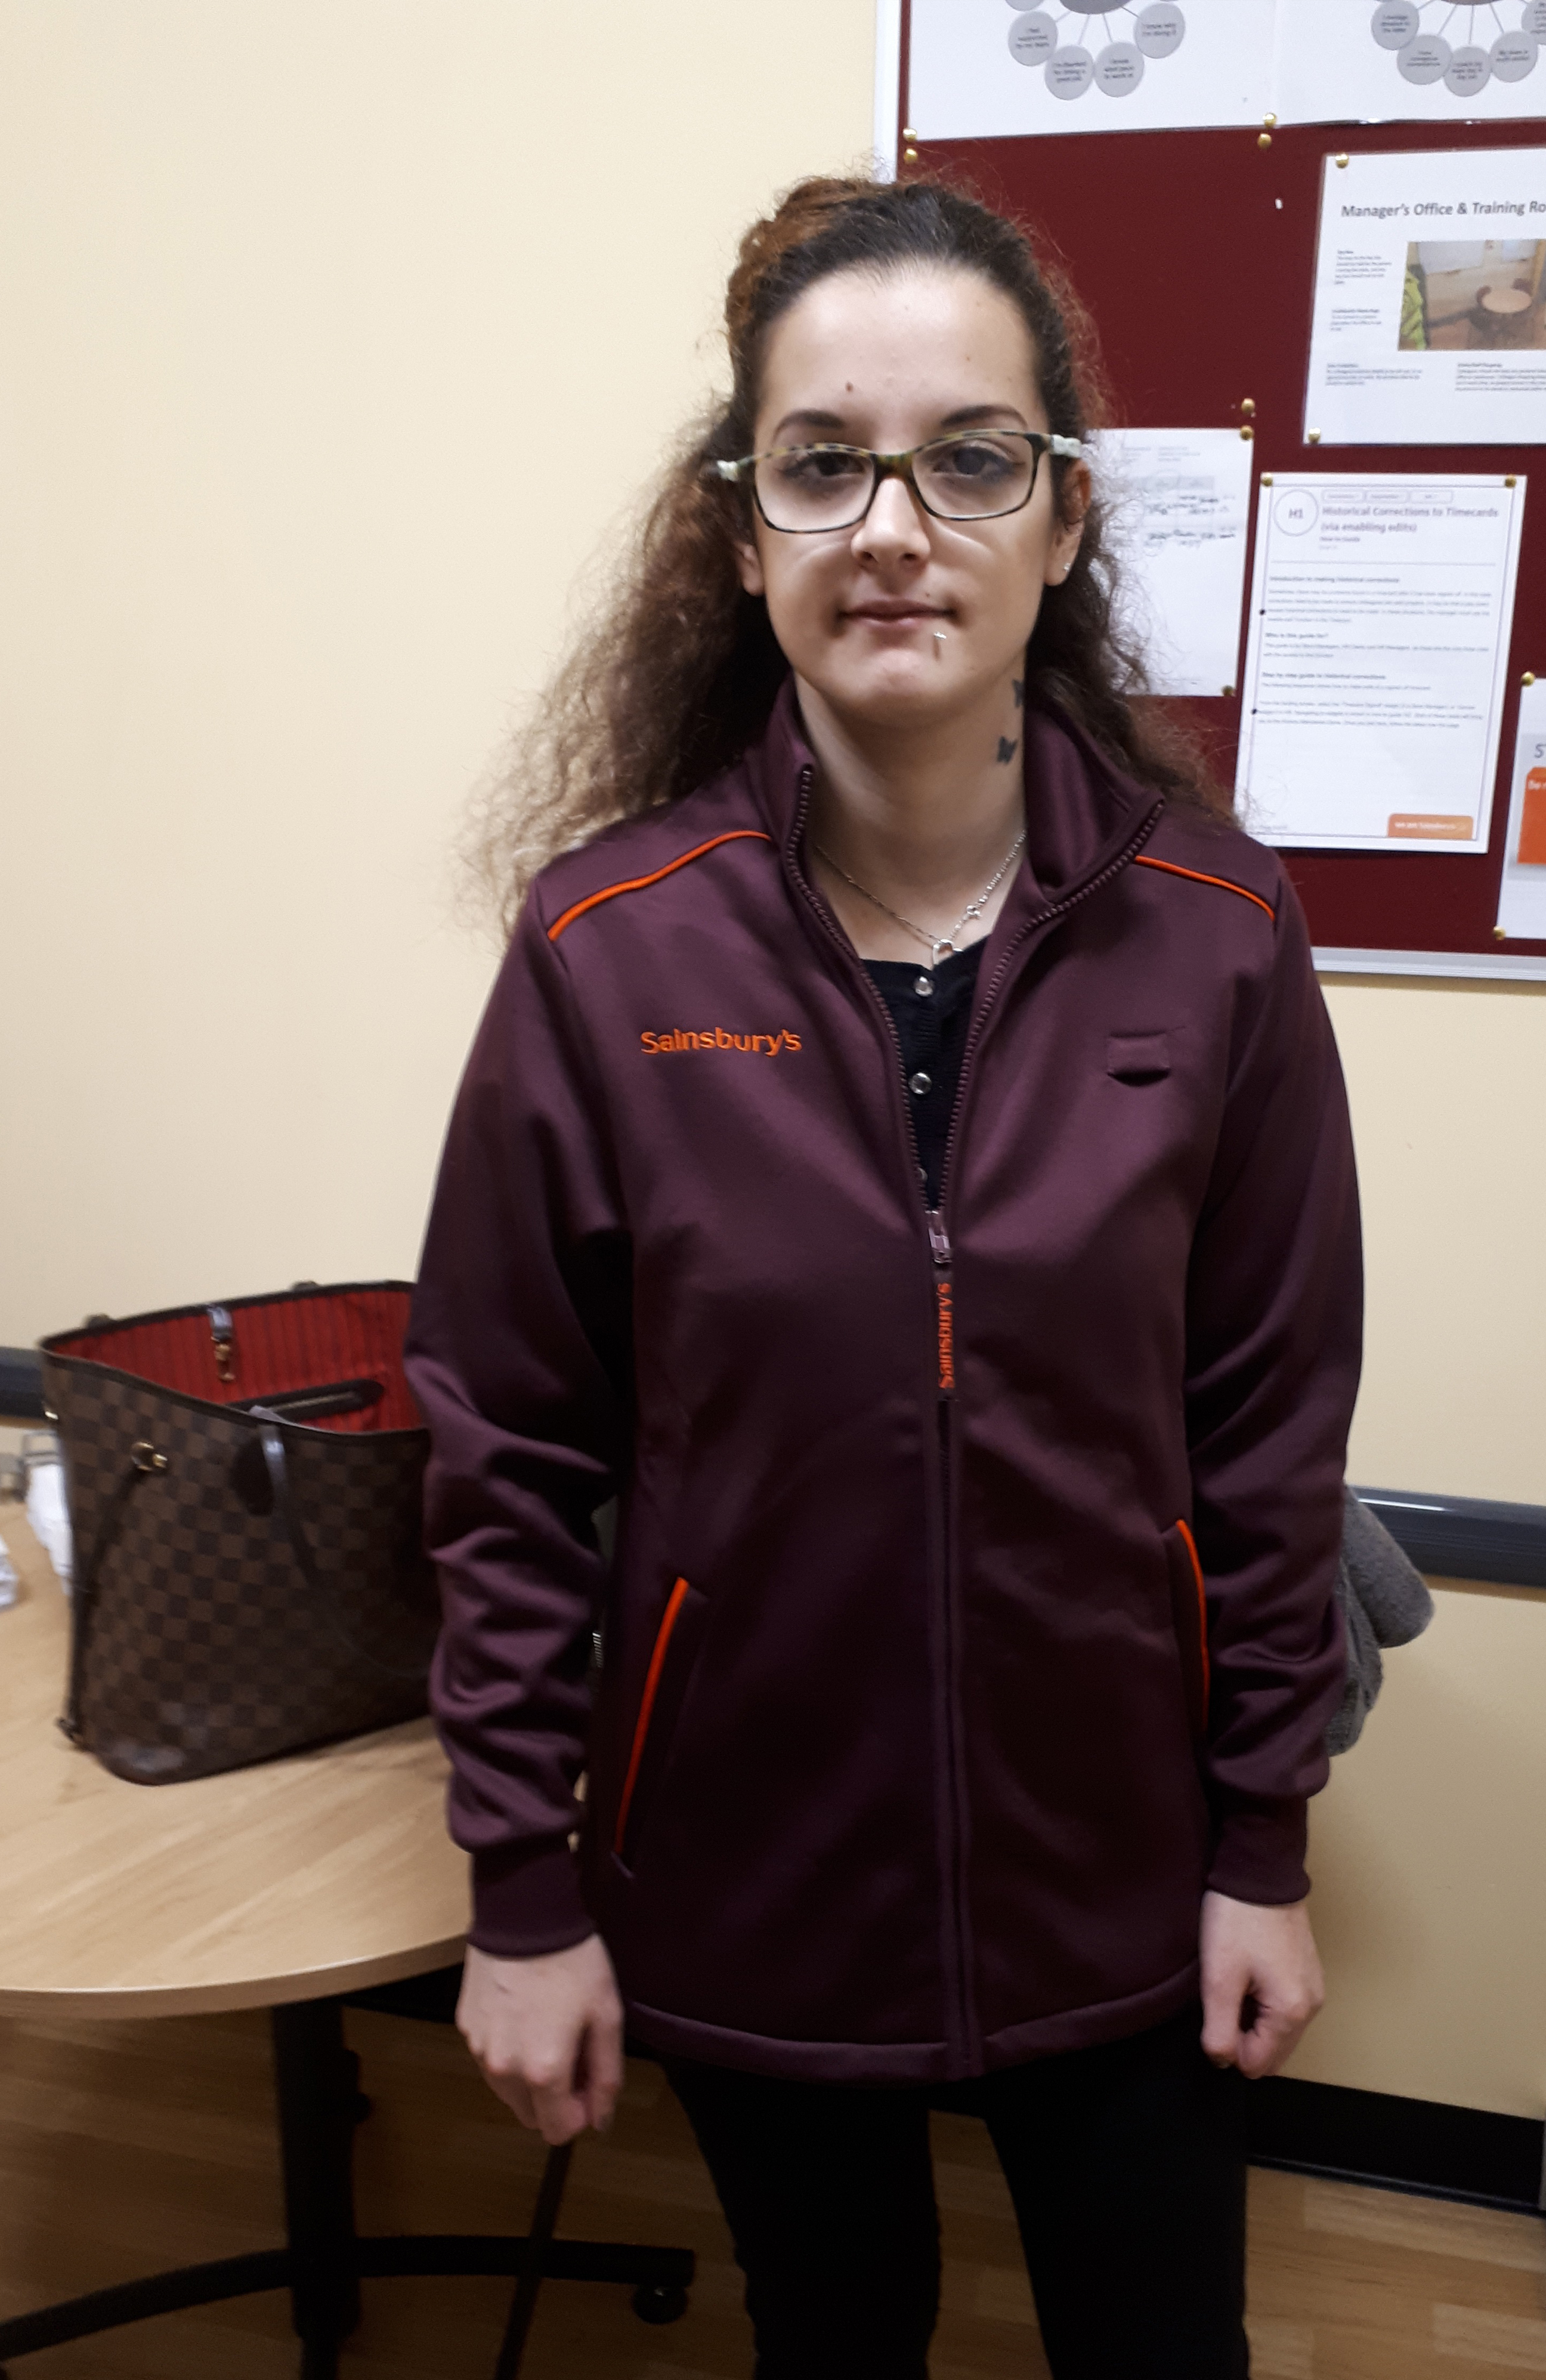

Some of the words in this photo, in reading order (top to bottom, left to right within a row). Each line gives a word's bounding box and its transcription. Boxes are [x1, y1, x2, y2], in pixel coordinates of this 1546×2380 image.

[1341, 203, 1410, 219] Manager's
[1414, 202, 1454, 216] Office
[1457, 202, 1468, 215] &
[1472, 200, 1526, 217] Training
[1288, 507, 1304, 519] H1
[1322, 505, 1371, 516] Historical
[1373, 507, 1430, 517] Corrections
[1431, 507, 1442, 517] to
[1446, 507, 1499, 518] Timecards
[1321, 521, 1340, 532] (via
[1341, 521, 1387, 535] enabling
[1388, 522, 1418, 533] edits)
[641, 1026, 802, 1057] Sainsbury's
[936, 1282, 954, 1389] Sainsbury's
